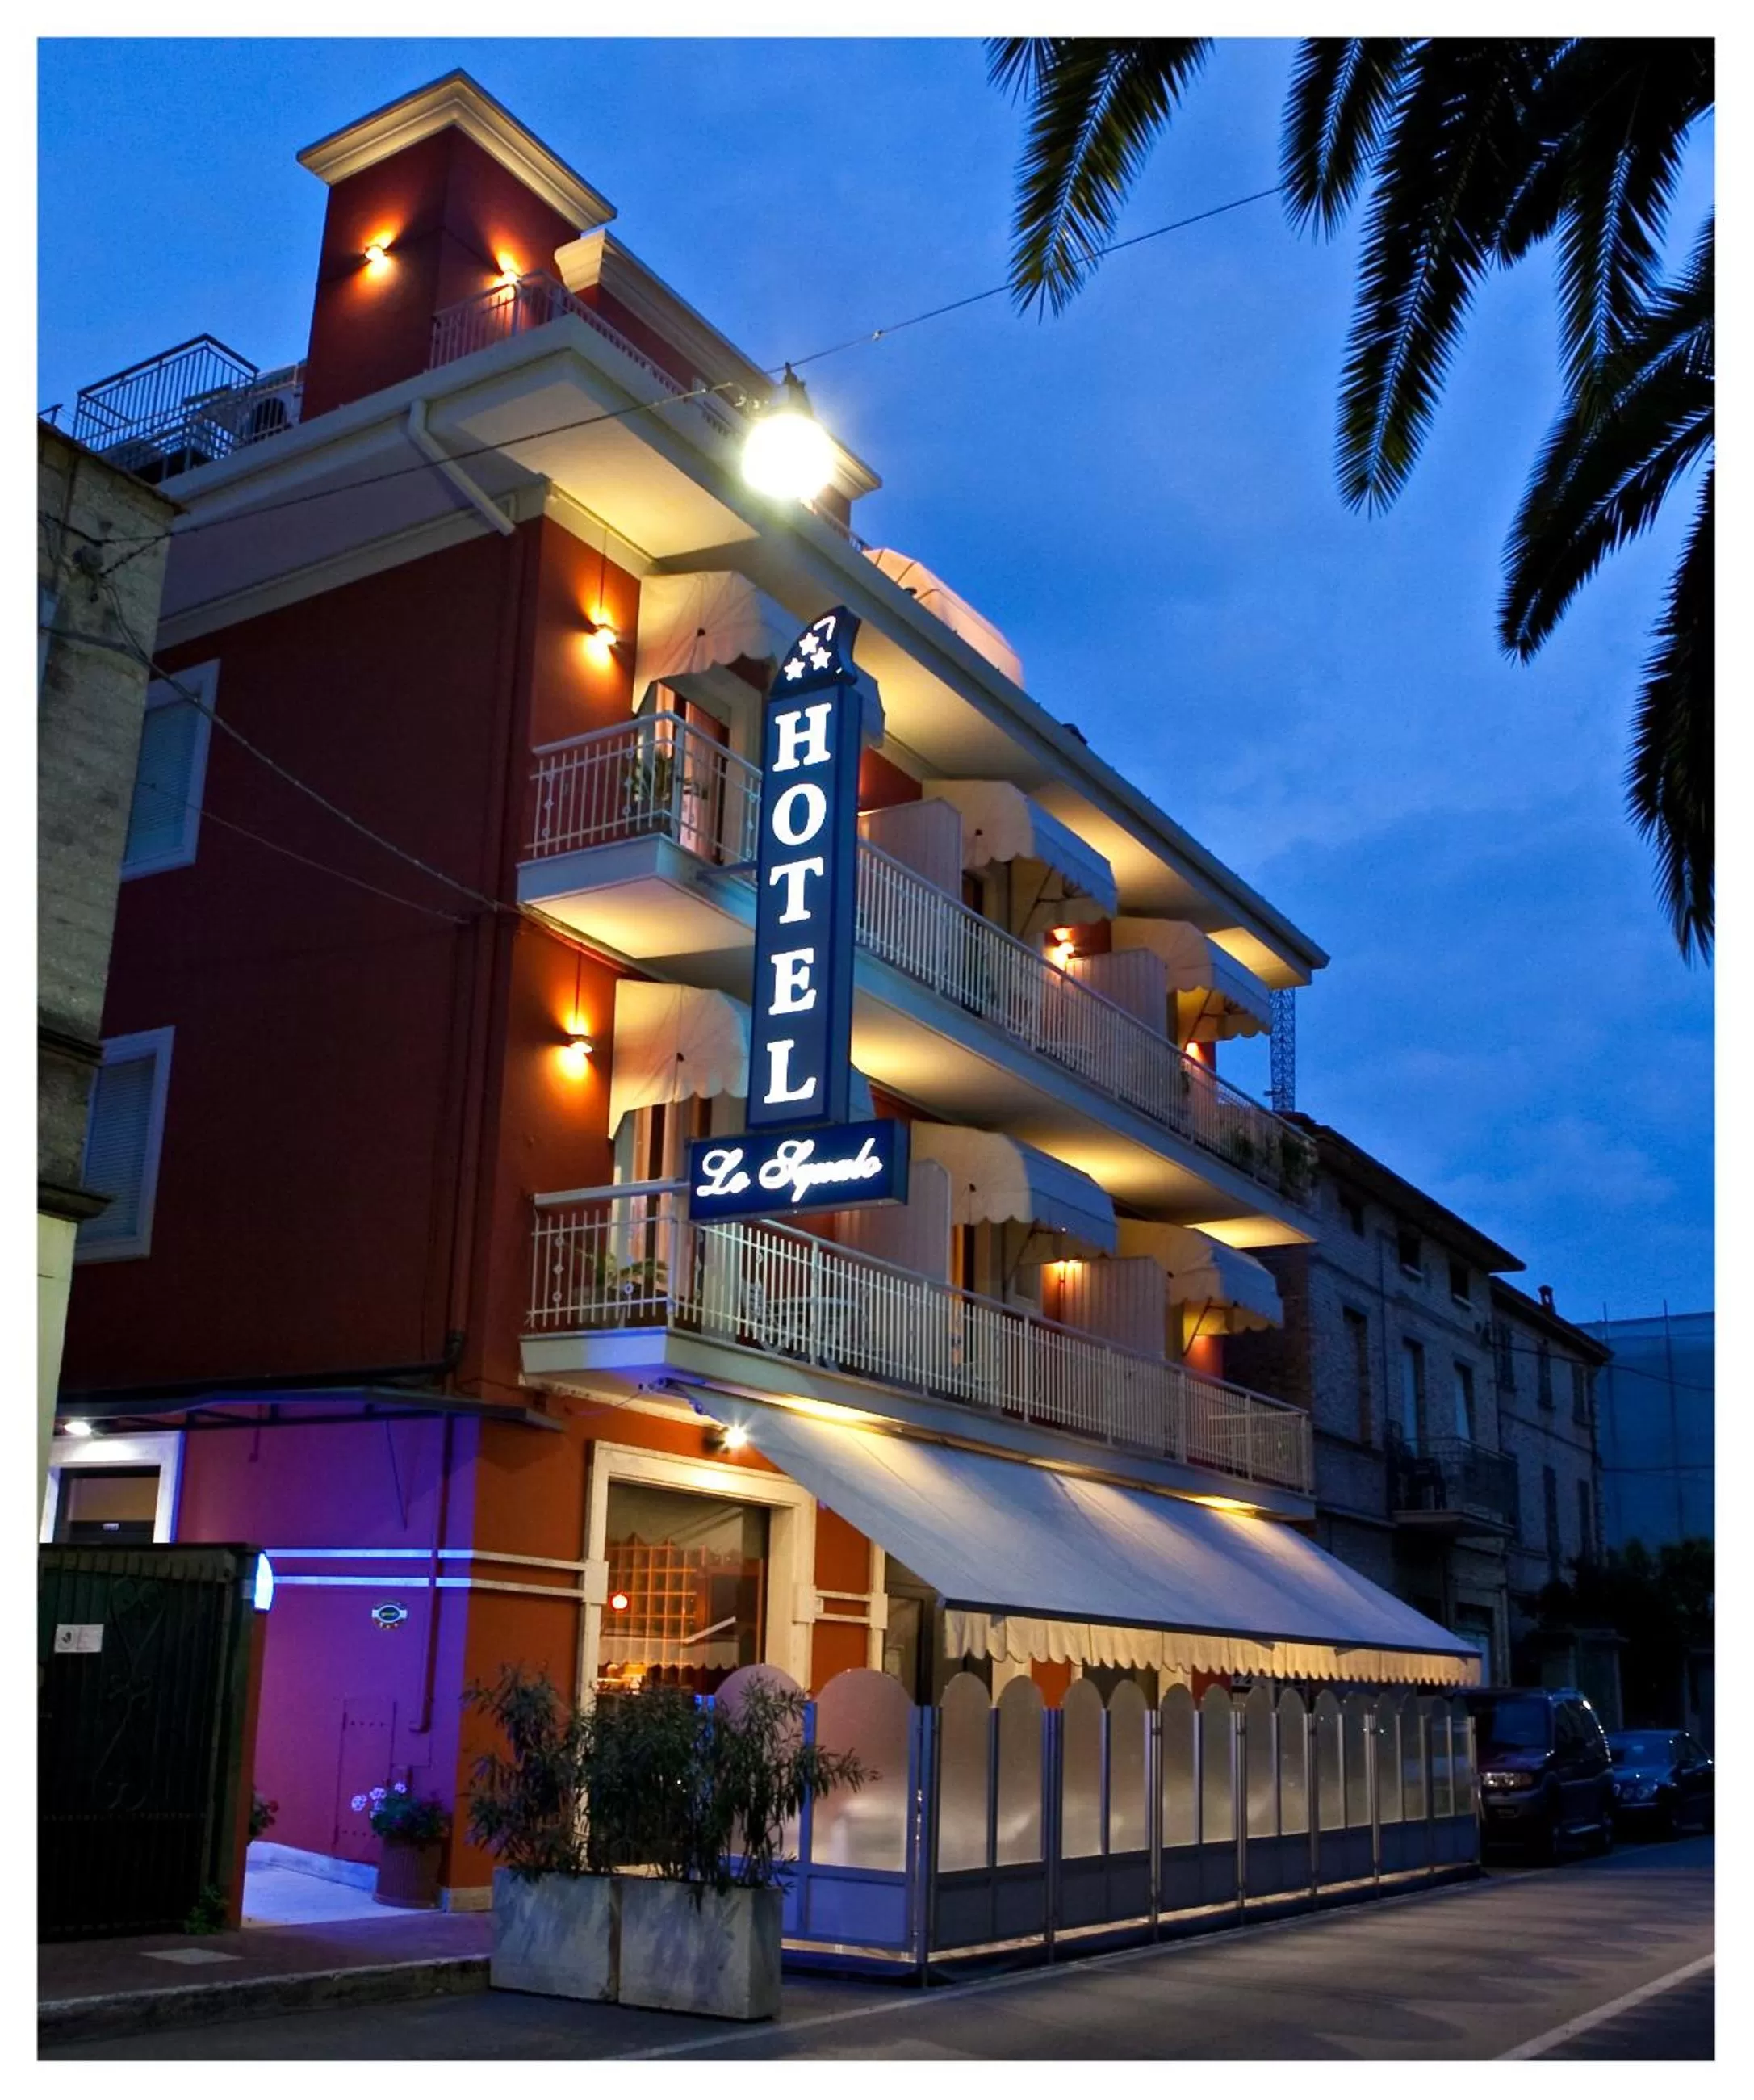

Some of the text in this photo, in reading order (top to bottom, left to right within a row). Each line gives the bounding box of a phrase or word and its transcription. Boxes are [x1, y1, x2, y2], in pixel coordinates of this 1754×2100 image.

[764, 702, 833, 1105] HOTEL
[696, 1137, 884, 1203] Lo Squalo
